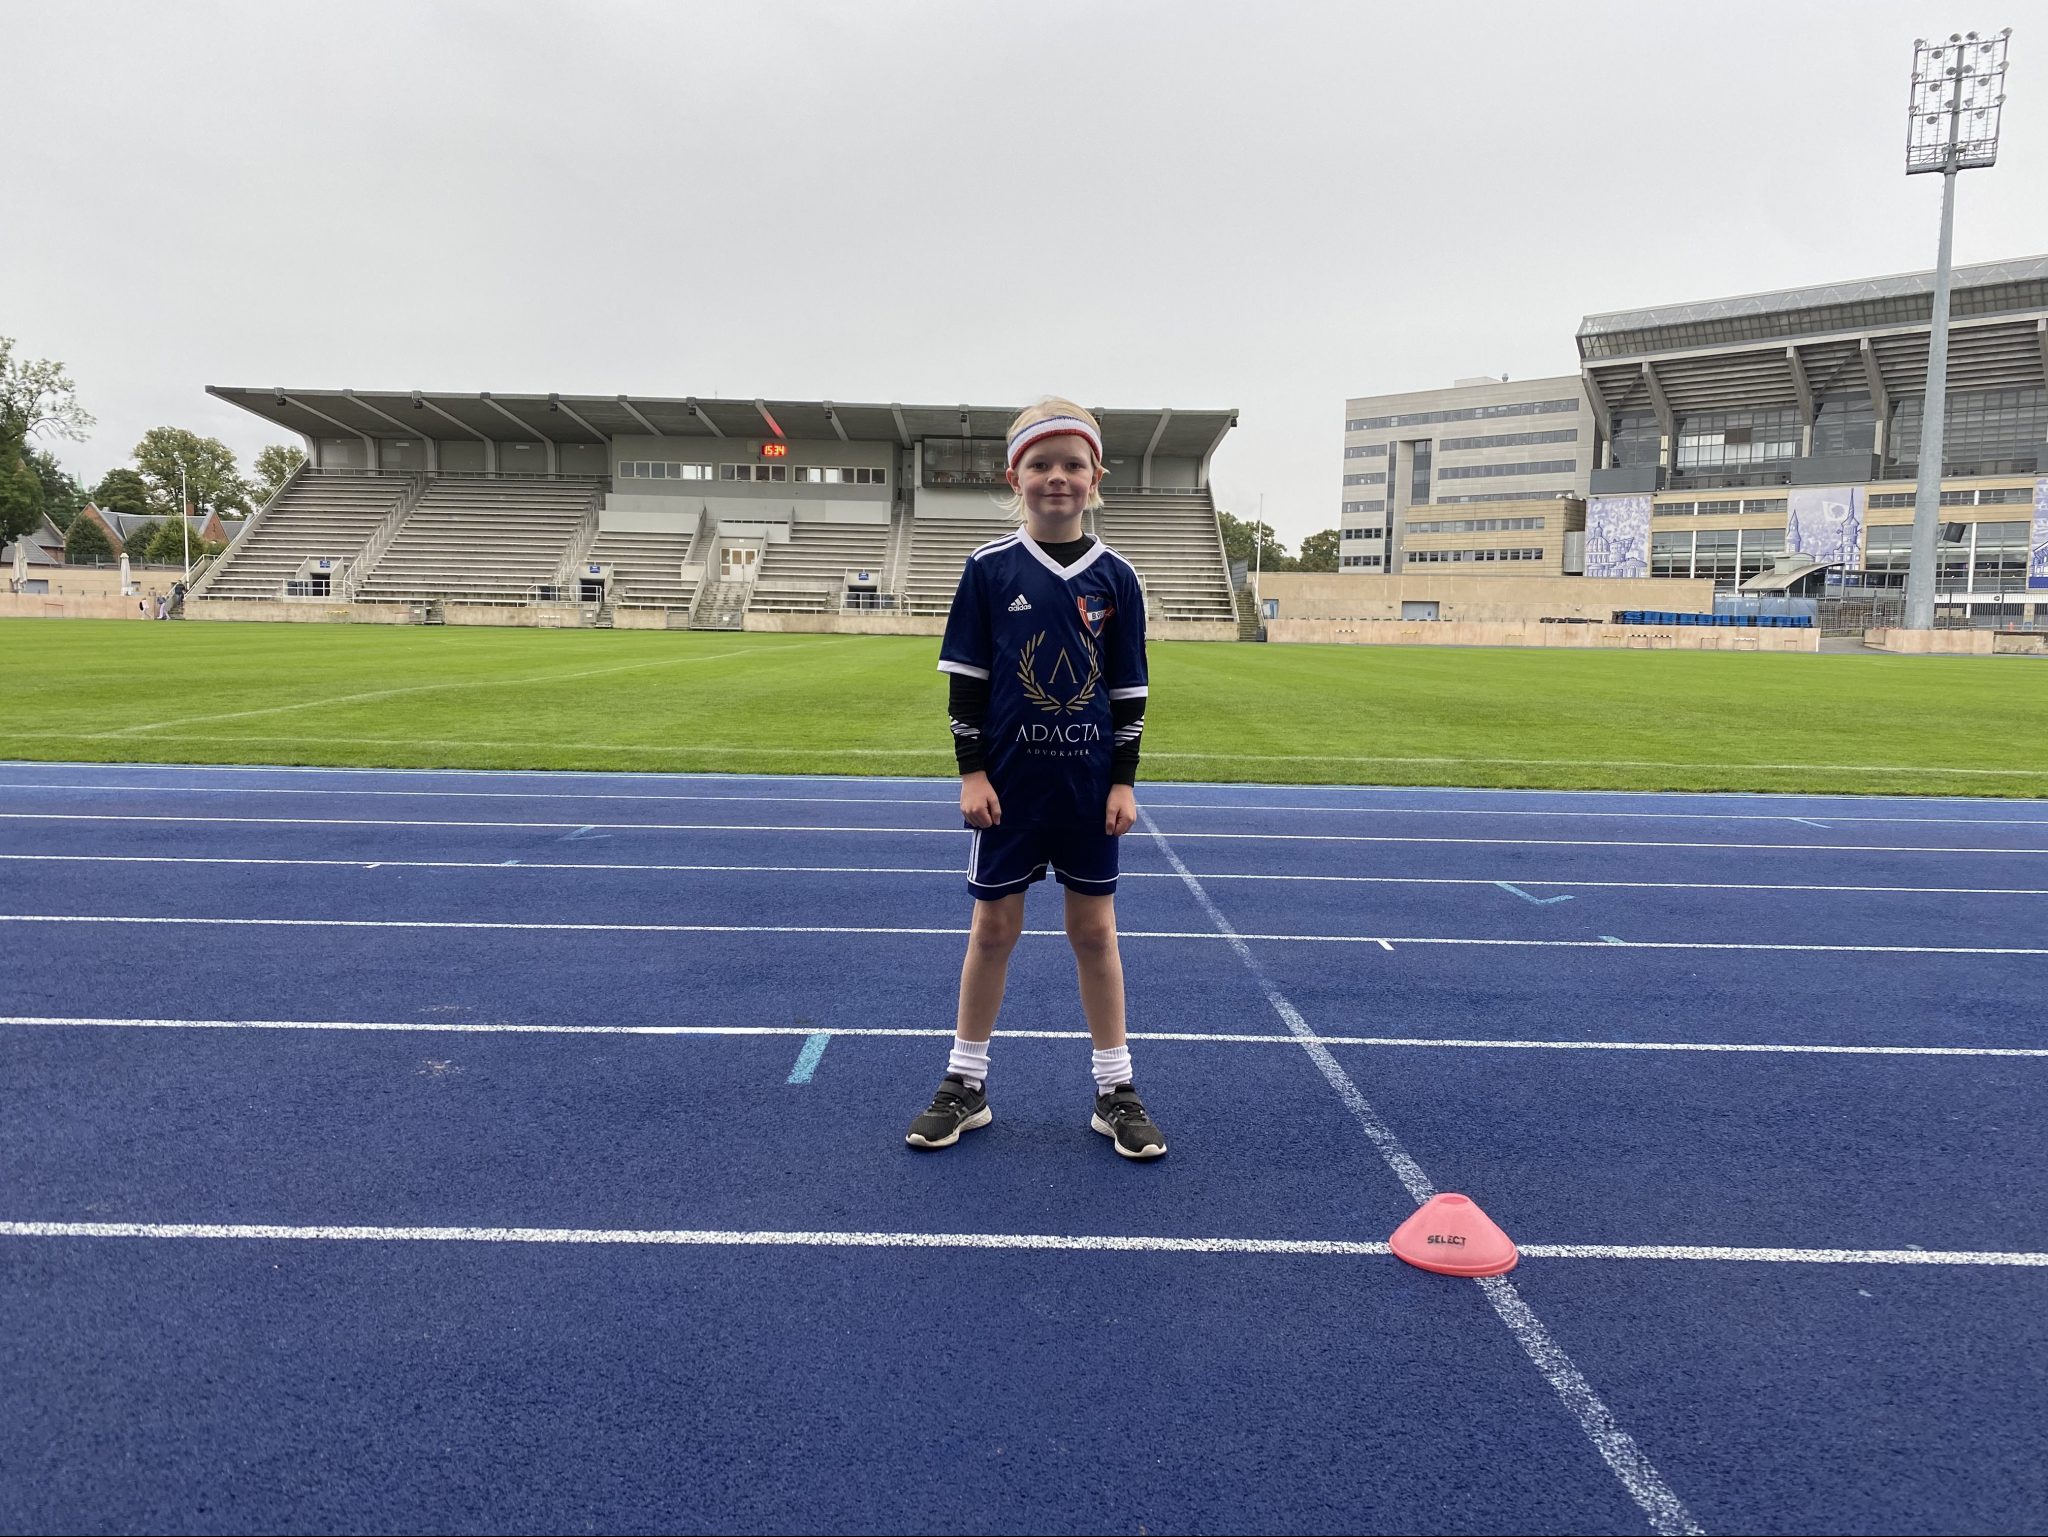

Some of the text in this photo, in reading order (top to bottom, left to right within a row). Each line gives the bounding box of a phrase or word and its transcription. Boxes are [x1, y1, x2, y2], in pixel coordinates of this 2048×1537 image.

[1008, 604, 1031, 612] adidas
[1016, 723, 1100, 743] ADACTA
[1026, 748, 1090, 757] ADVOKATER
[1427, 1235, 1467, 1247] SELECT
